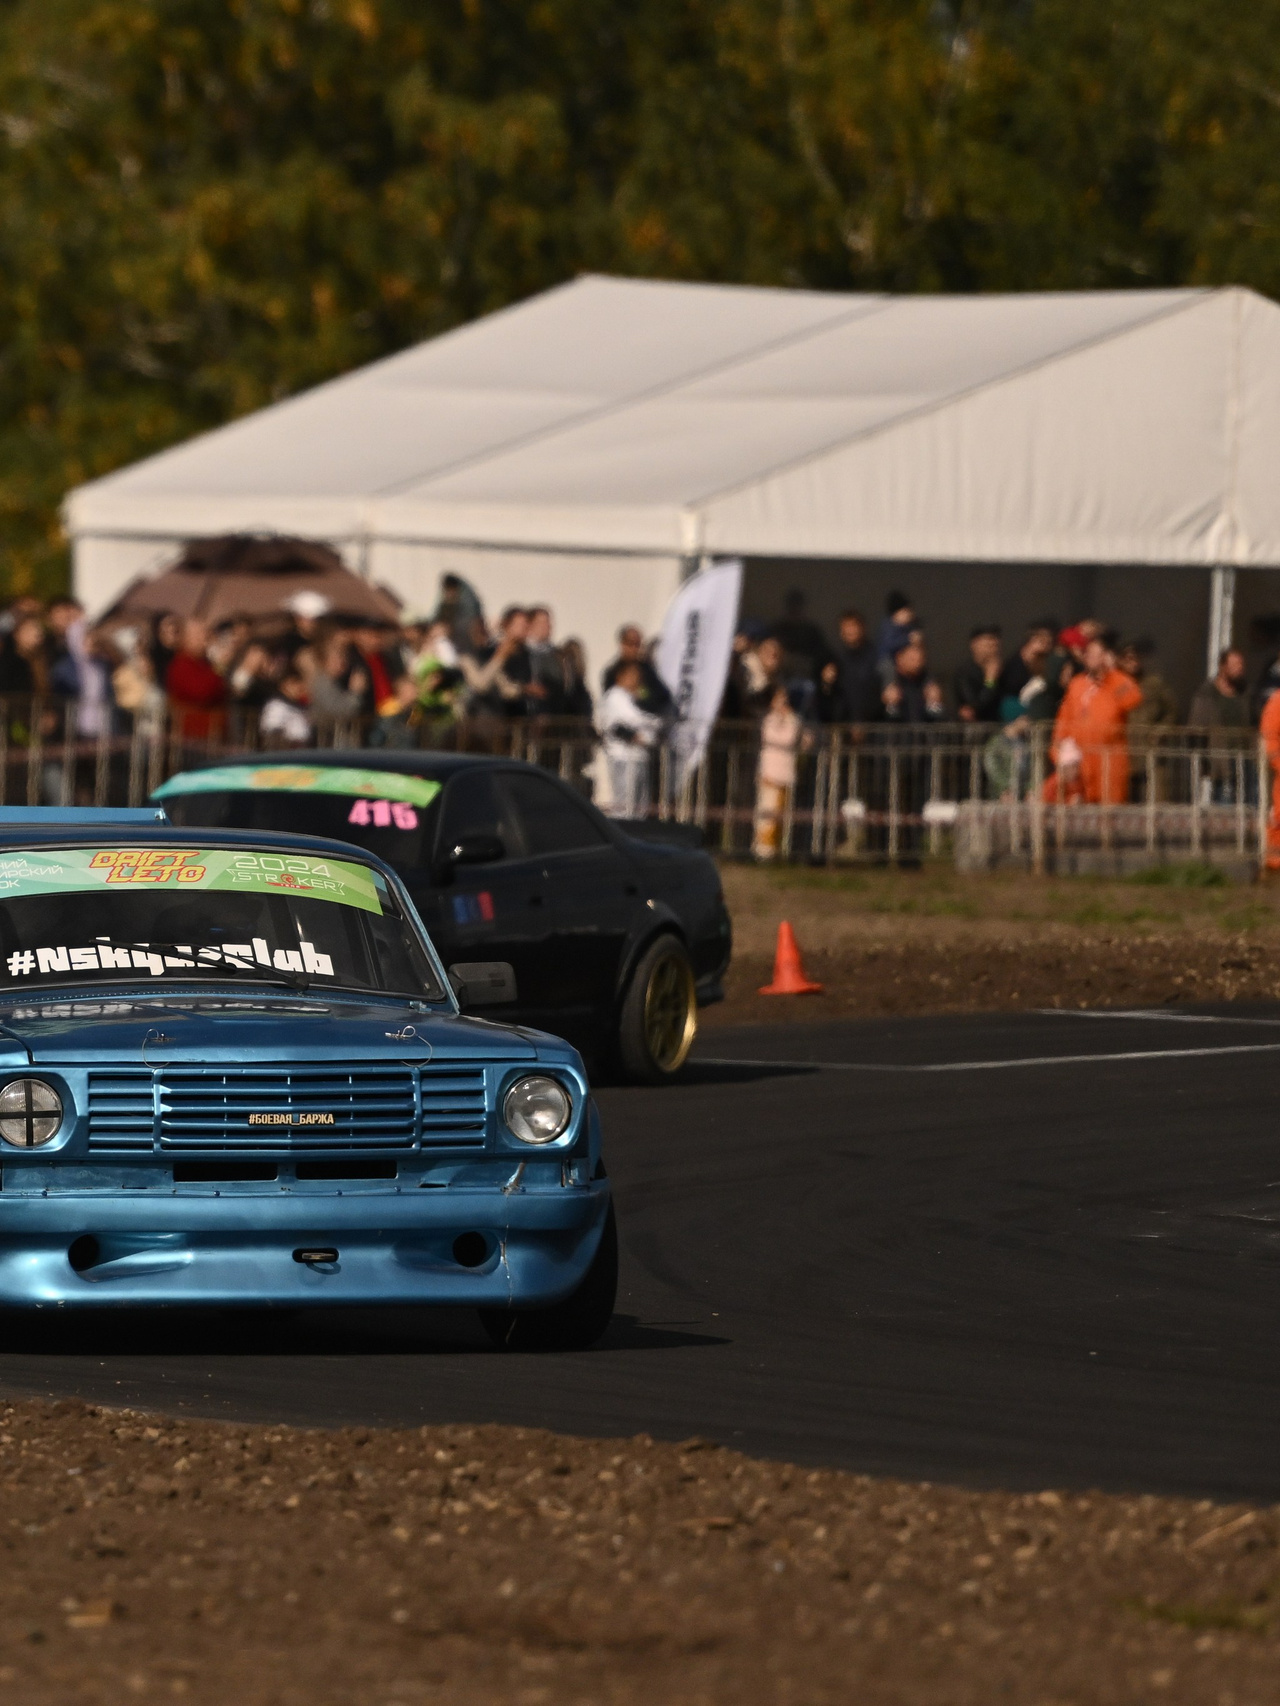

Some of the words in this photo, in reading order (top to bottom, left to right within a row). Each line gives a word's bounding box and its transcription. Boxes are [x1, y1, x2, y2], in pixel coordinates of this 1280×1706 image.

[89, 851, 201, 868] DRIFT
[233, 855, 331, 878] 2024
[105, 865, 207, 883] LETO
[248, 1113, 335, 1125] #БОЕВАЯ_БАРЖА
